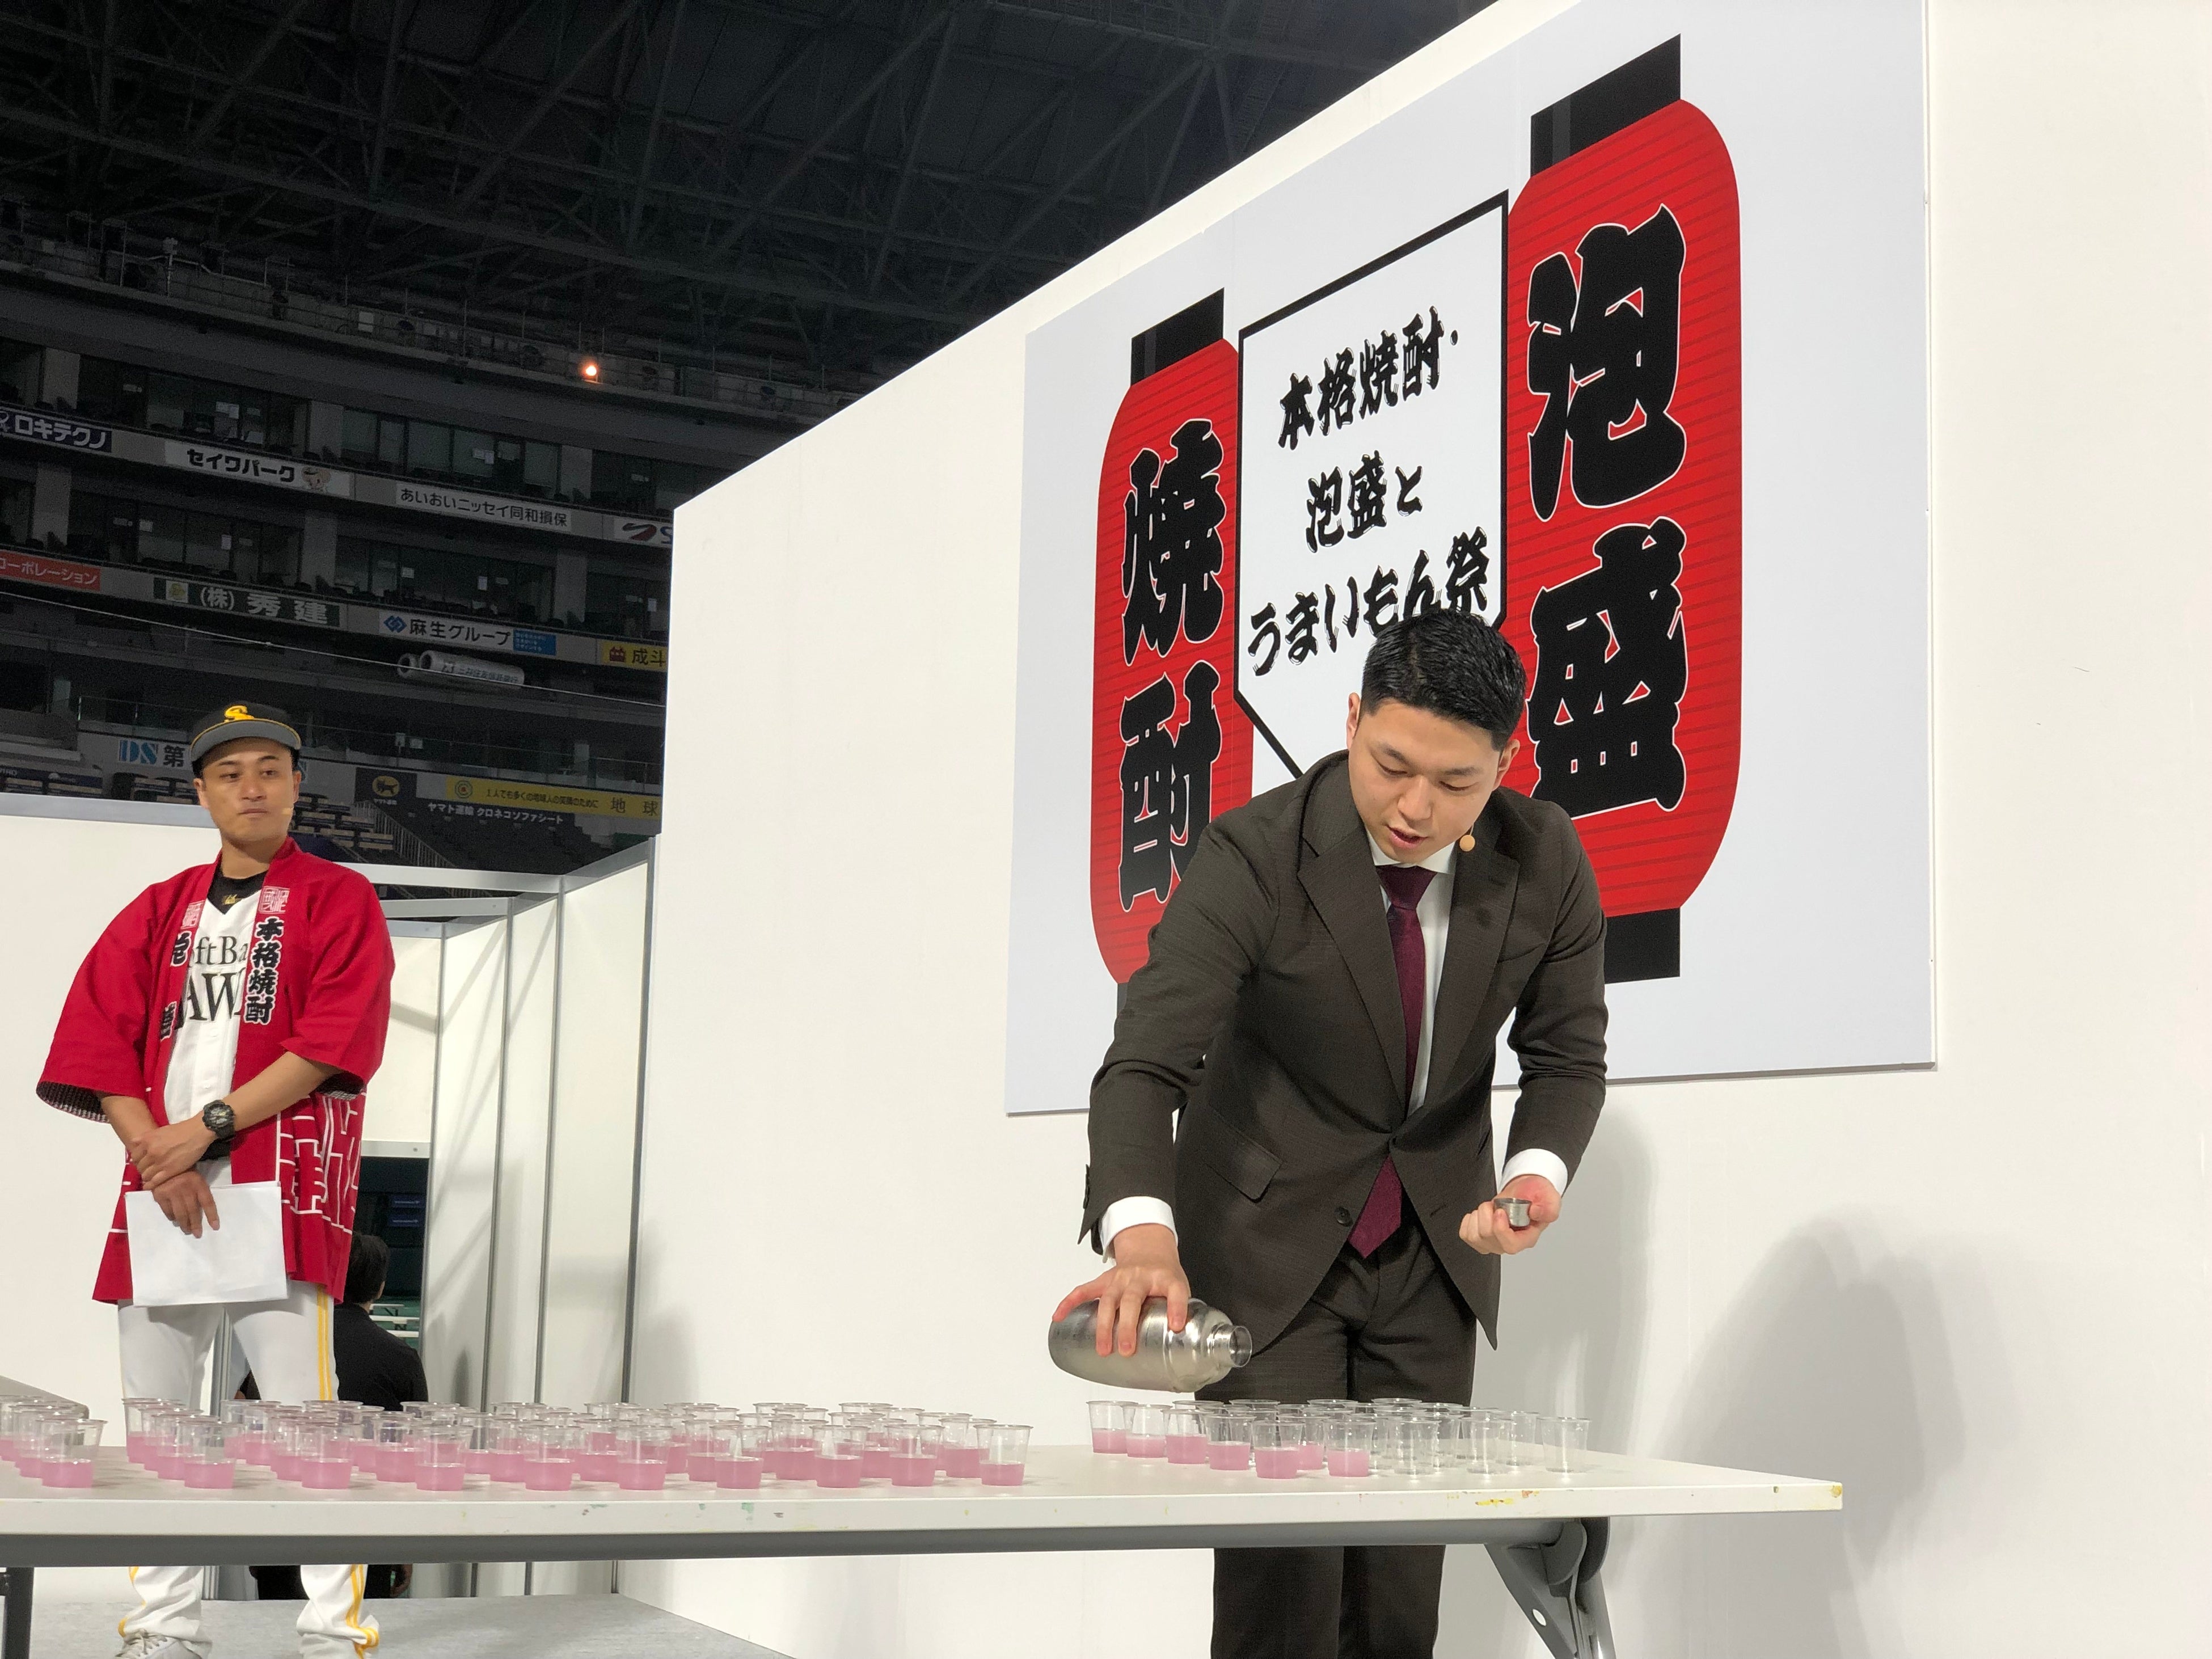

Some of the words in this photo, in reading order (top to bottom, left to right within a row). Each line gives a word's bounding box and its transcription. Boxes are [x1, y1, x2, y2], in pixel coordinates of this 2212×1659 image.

[15, 415, 106, 449] ロキテクノ
[187, 448, 295, 483] セイワパーク
[400, 488, 567, 528] あいおいニッセイ同和損保
[1306, 449, 1423, 554] 泡盛と
[1526, 203, 1688, 818] 泡盛
[1248, 526, 1489, 677] うまいもん祭
[409, 618, 510, 645] 麻生グループ
[477, 807, 564, 825] クロネコソファシート
